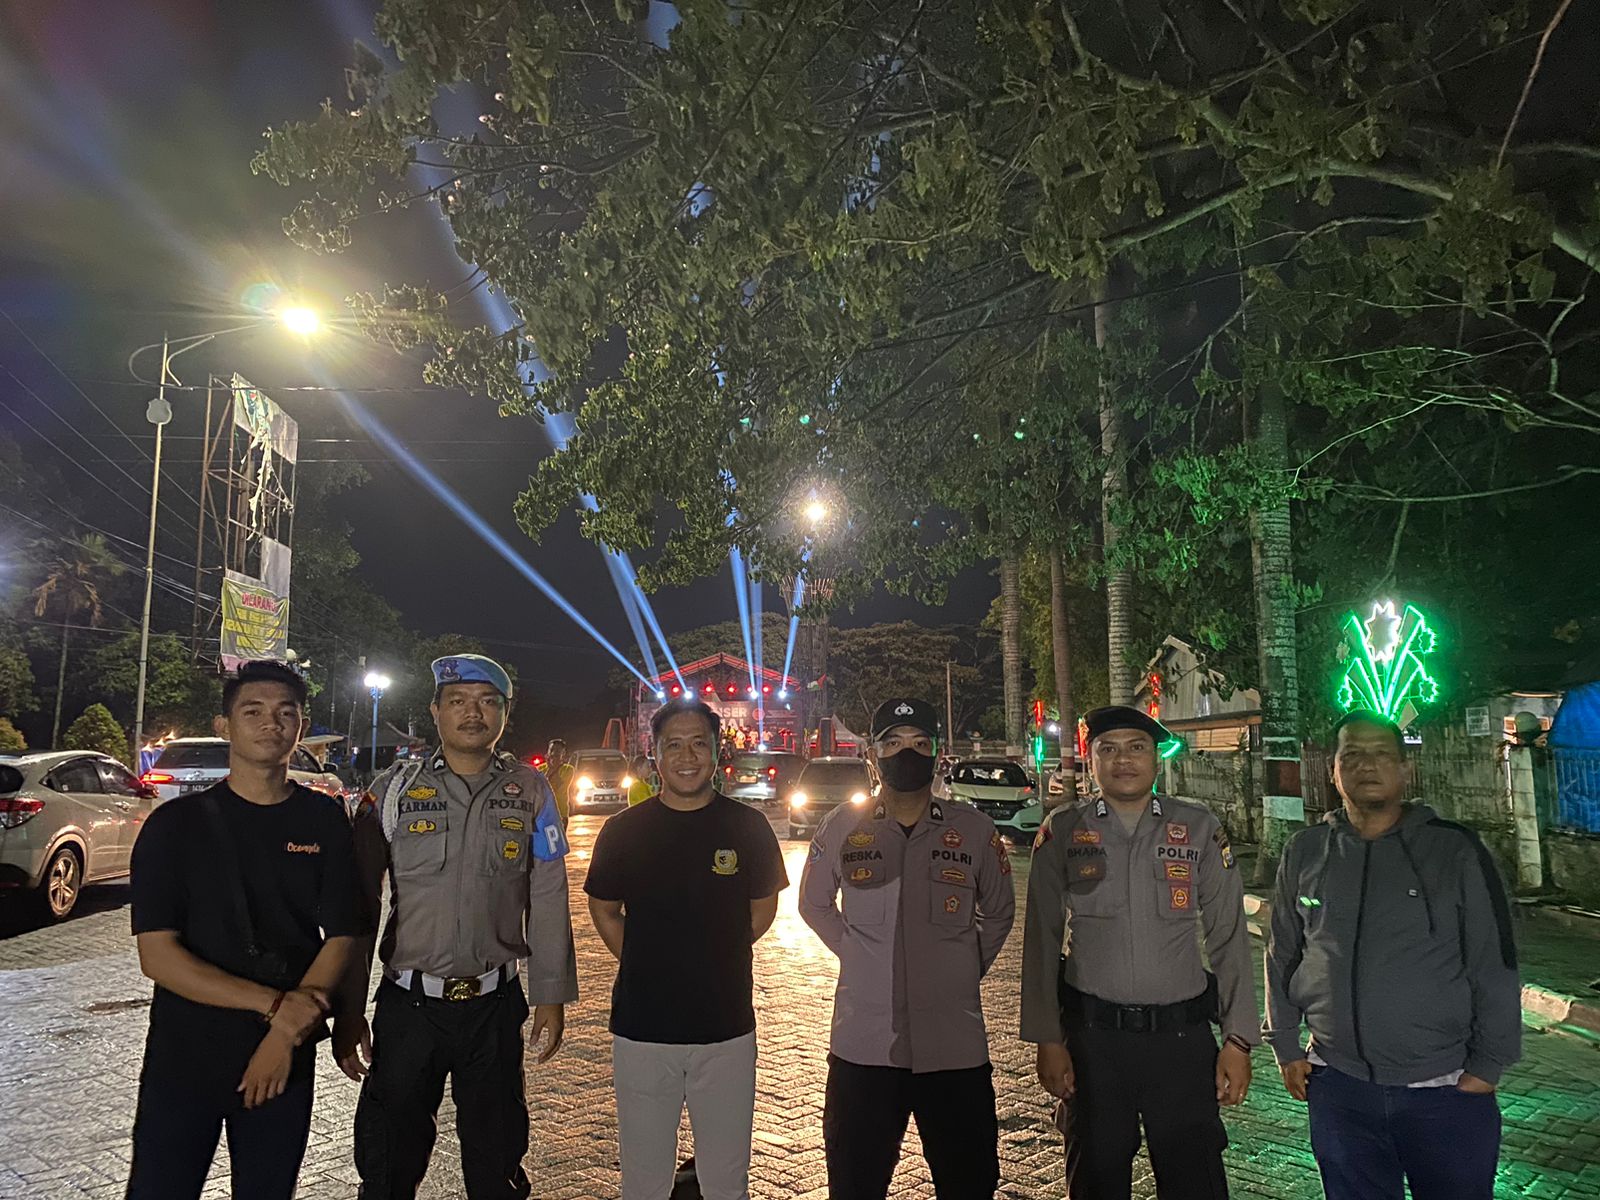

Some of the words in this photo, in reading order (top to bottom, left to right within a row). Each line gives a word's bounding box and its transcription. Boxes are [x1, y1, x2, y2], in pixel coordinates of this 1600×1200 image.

[488, 798, 534, 813] POLRI
[842, 850, 882, 864] RESKA
[931, 849, 972, 865] POLRI
[1157, 846, 1198, 862] POLRI
